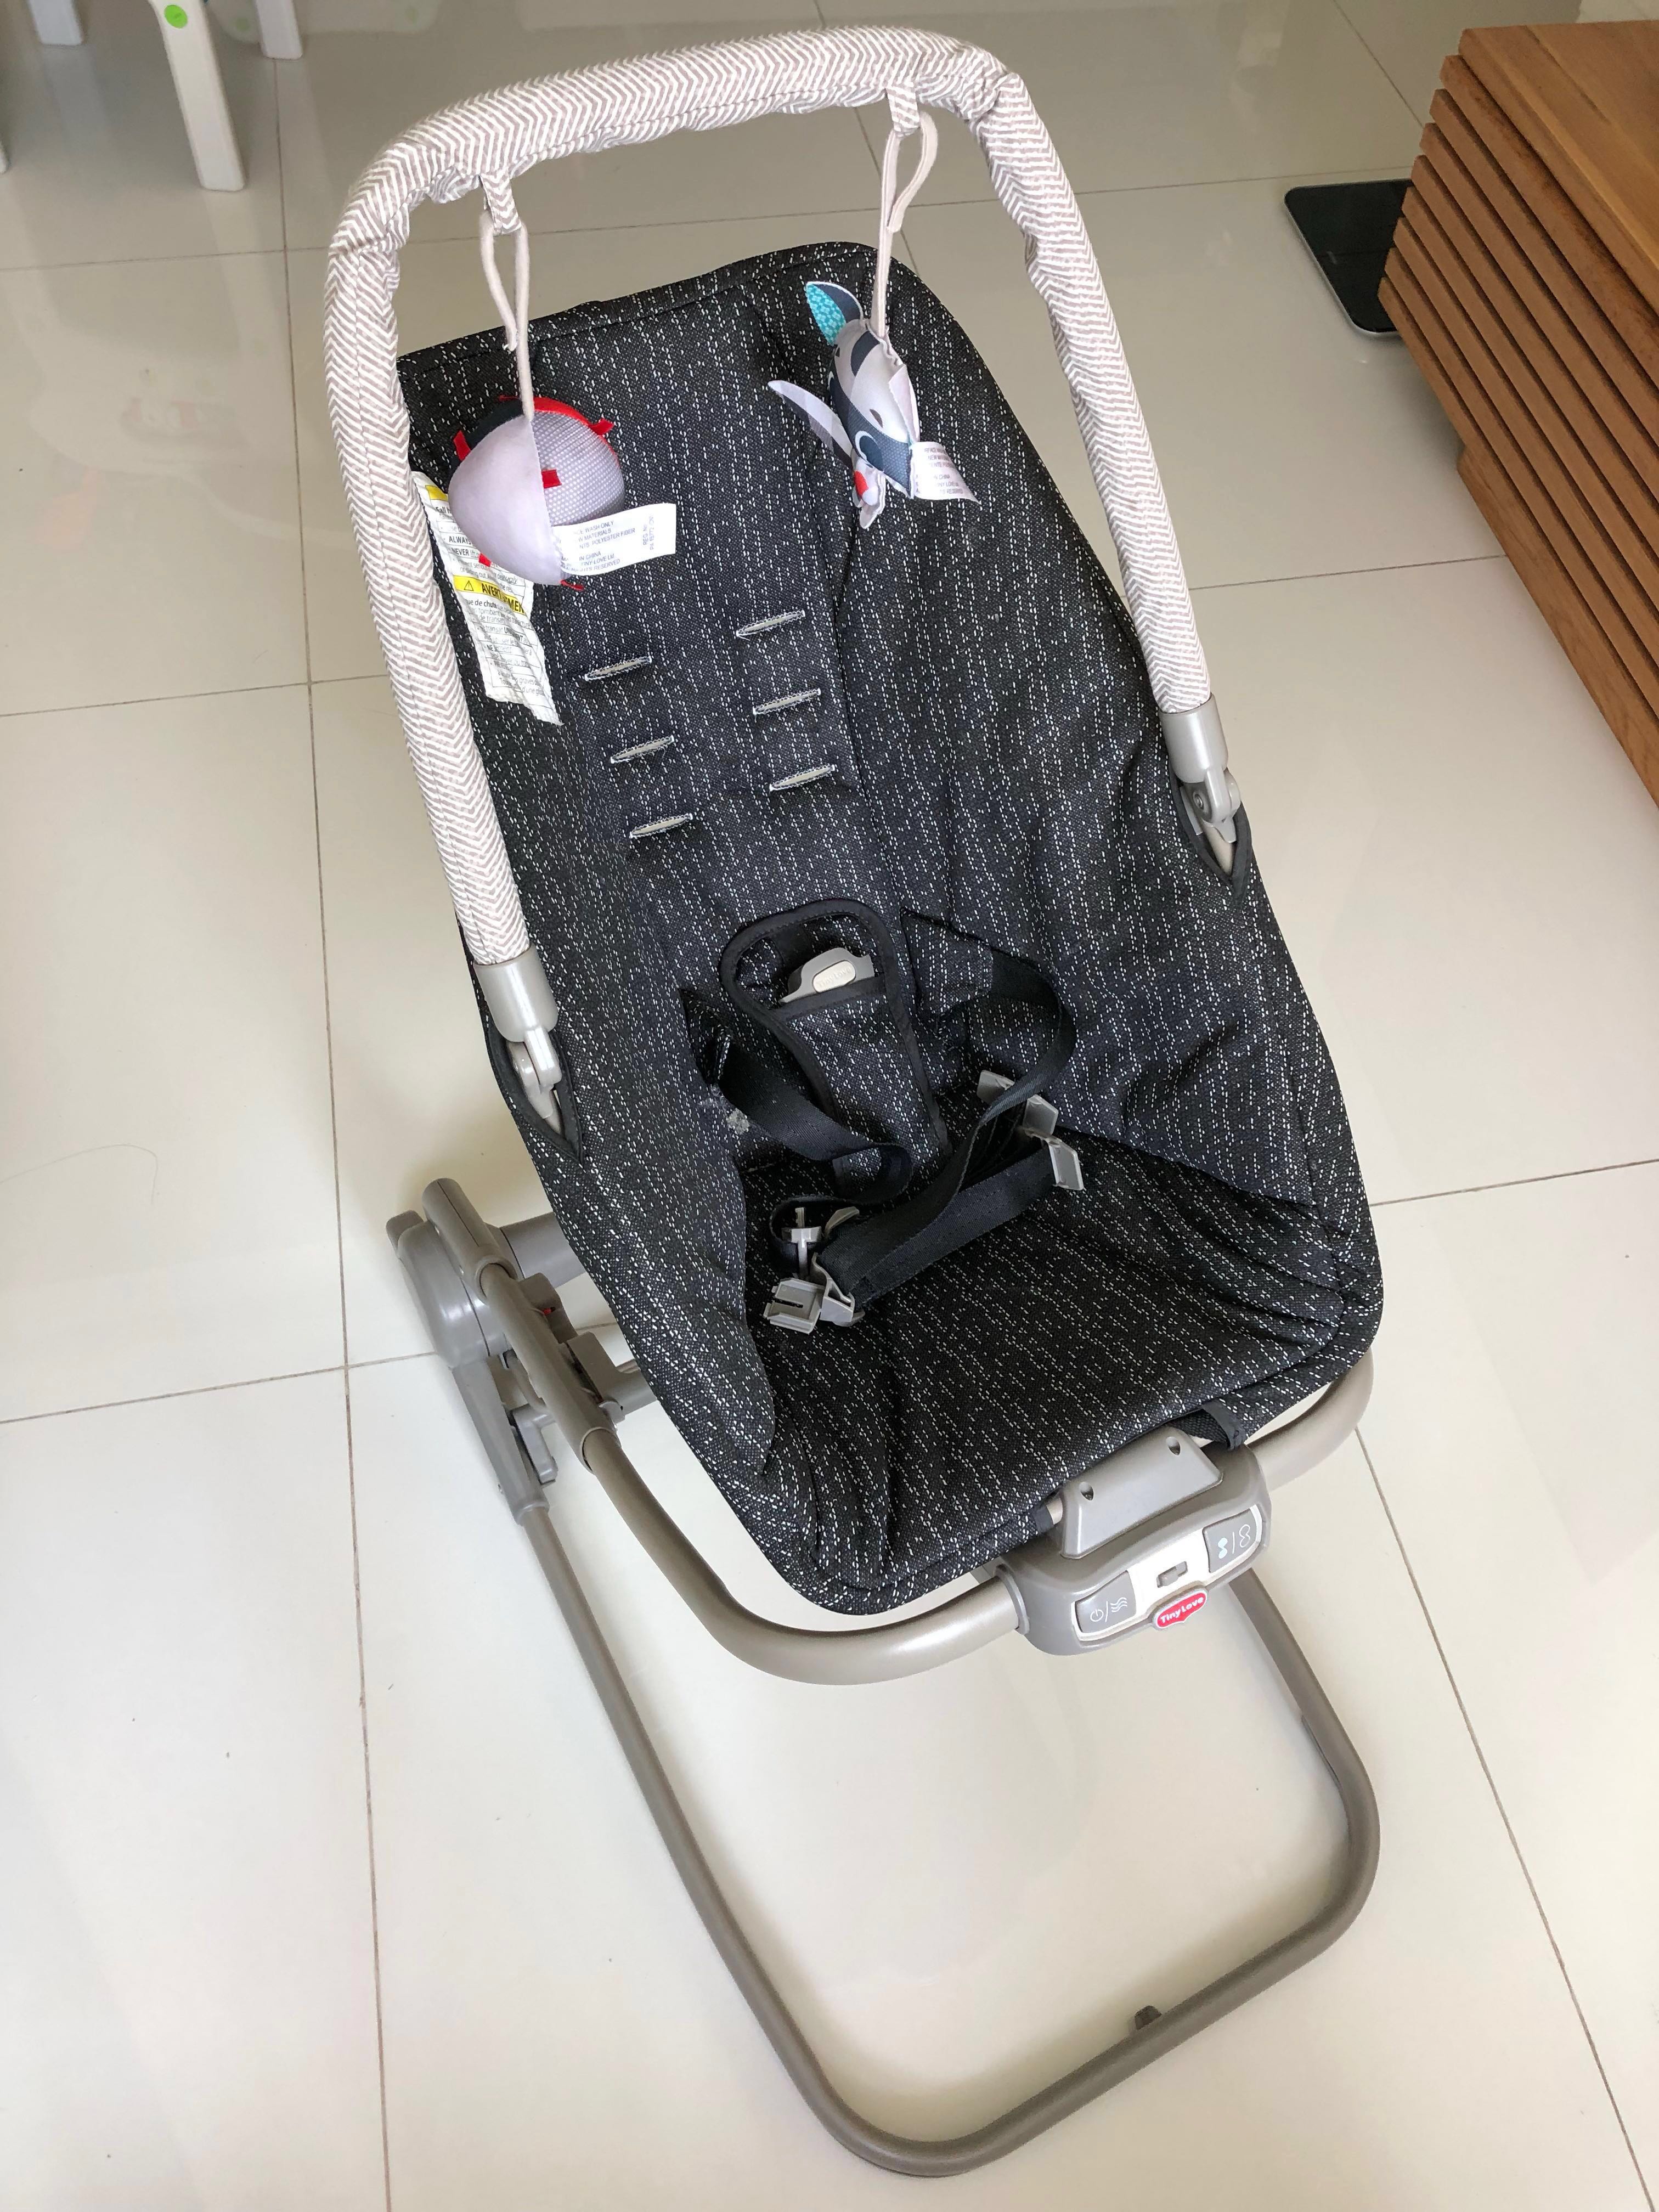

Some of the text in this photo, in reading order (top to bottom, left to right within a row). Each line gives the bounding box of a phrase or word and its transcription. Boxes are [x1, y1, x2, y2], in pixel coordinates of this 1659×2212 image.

[585, 524, 600, 533] WASH
[600, 520, 614, 529] ONLY
[584, 528, 612, 541] MATERIALS
[591, 532, 620, 546] POLYESTER
[451, 547, 470, 556] NEVER
[585, 550, 601, 560] CHINA
[594, 558, 620, 571] RESERVED
[1160, 1596, 1204, 1623] Tiny Love
